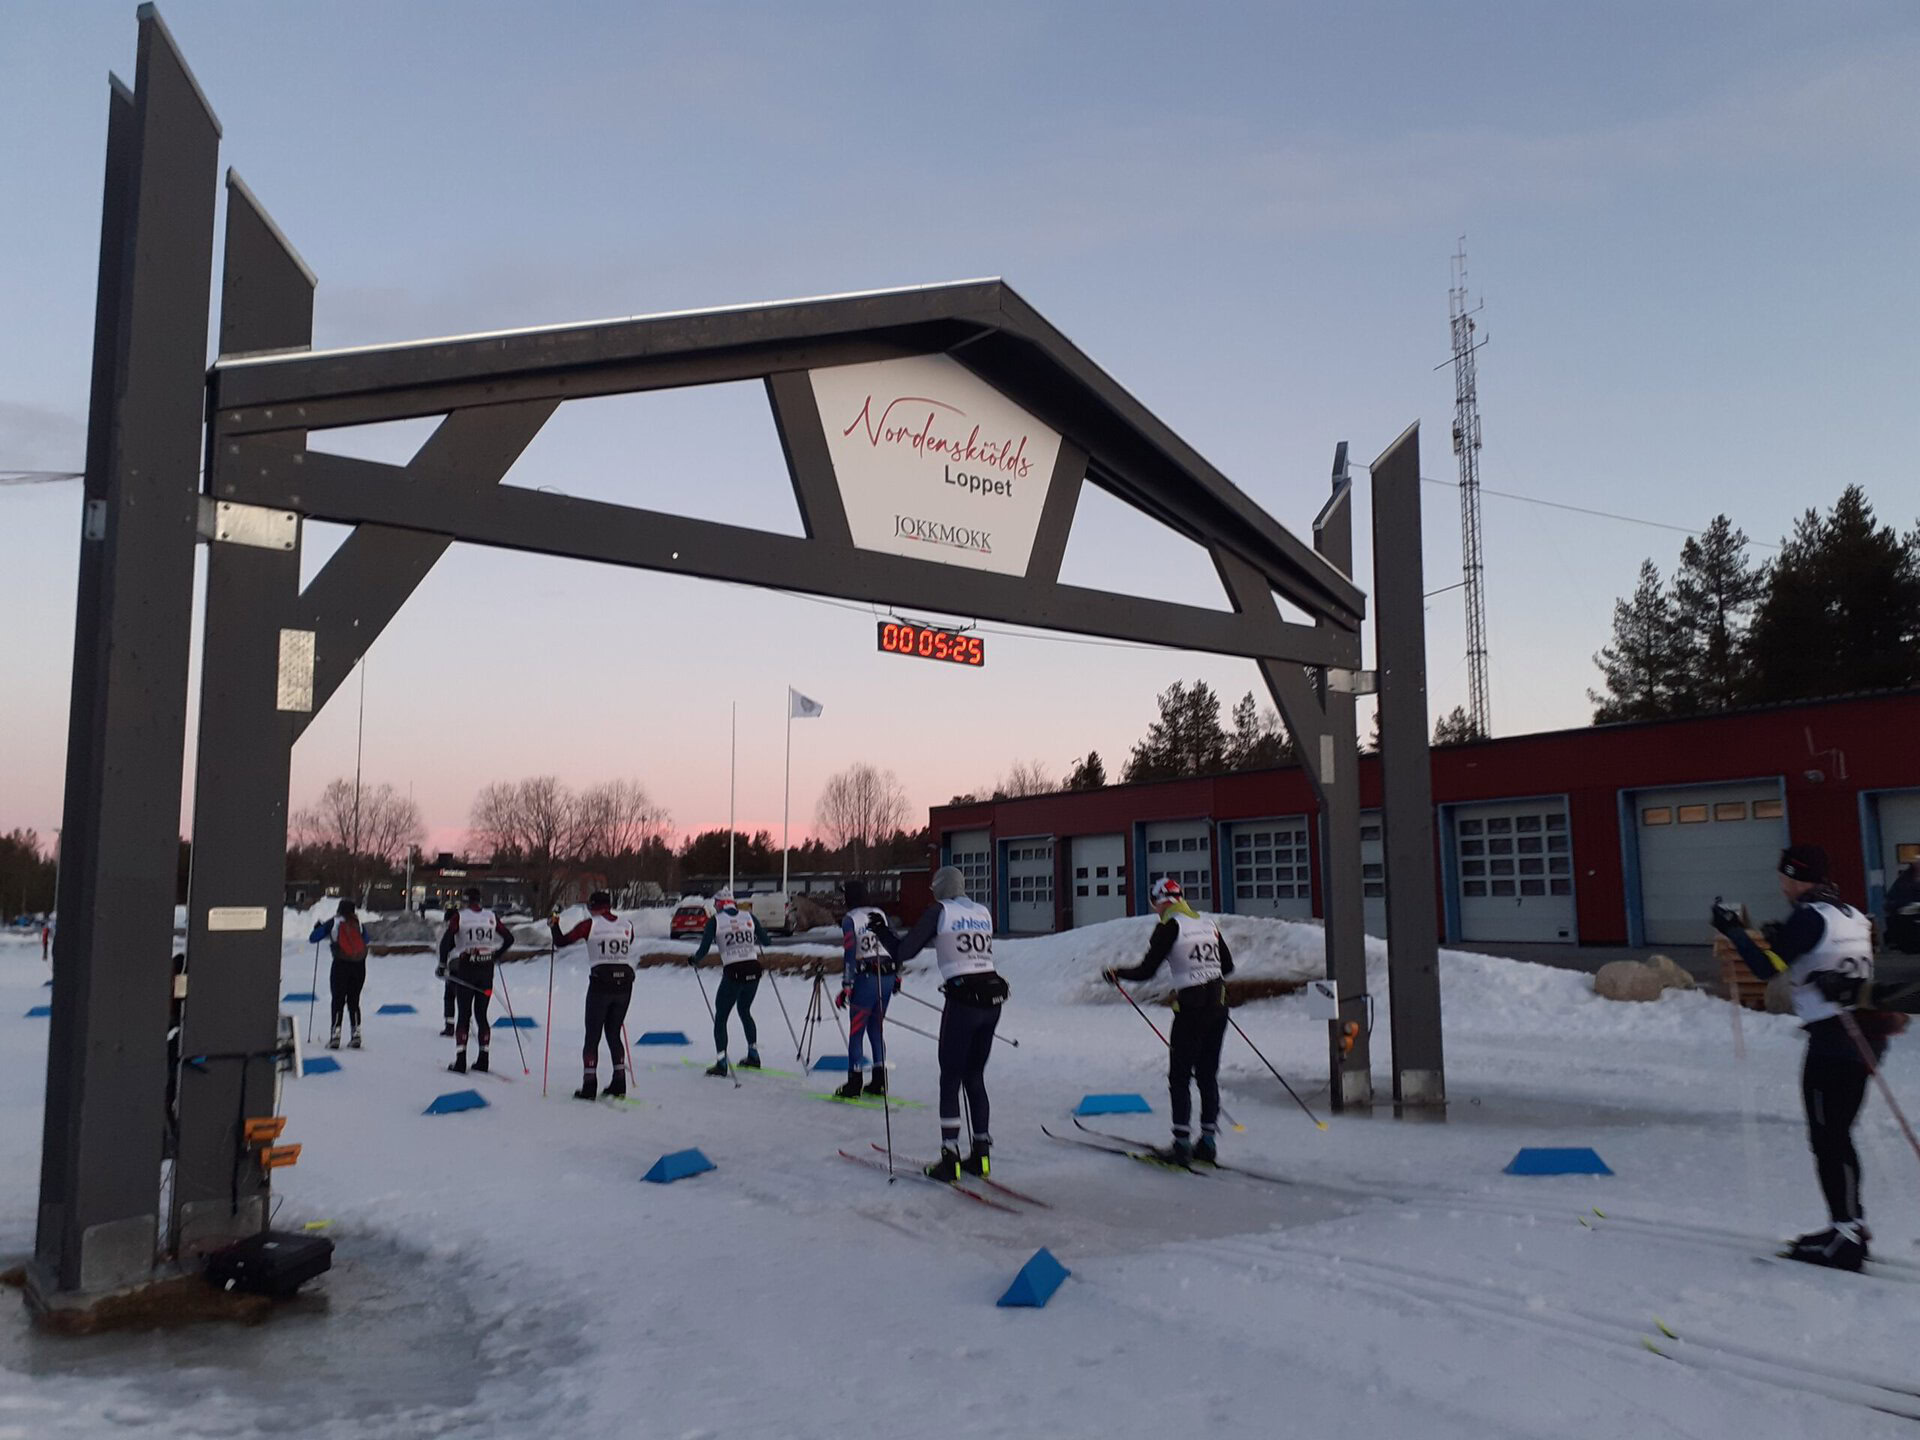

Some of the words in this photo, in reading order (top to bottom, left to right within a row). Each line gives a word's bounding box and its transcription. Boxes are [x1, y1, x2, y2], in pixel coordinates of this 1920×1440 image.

[944, 464, 1012, 497] Loppet
[894, 514, 992, 550] JOKKMOKK
[882, 623, 914, 653] 00
[466, 927, 493, 941] 194
[725, 931, 753, 947] 288
[956, 933, 993, 954] 302
[597, 939, 629, 955] 195
